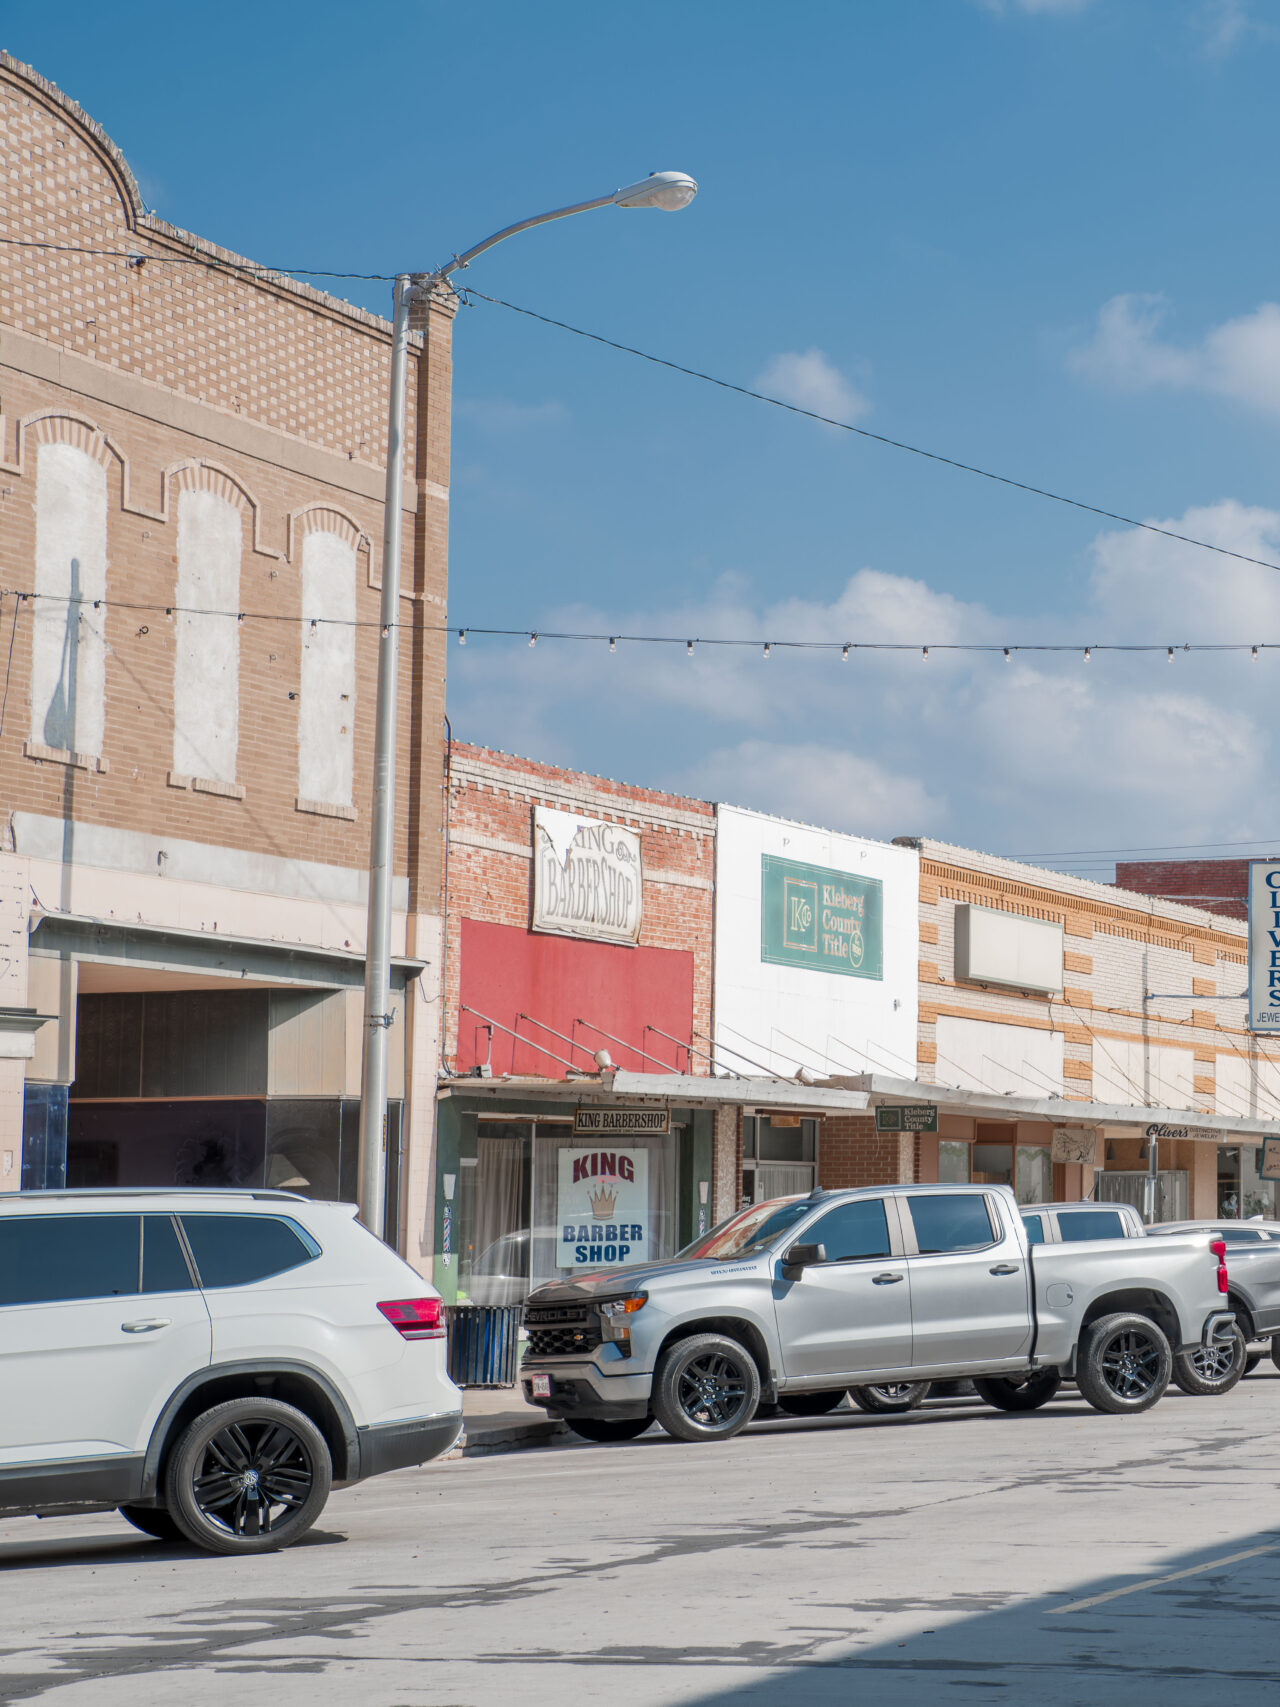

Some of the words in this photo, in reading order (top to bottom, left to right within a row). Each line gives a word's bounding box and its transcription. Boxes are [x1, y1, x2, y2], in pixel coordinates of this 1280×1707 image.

[573, 826, 615, 854] ING
[546, 857, 634, 928] BARBERSHOP
[822, 884, 865, 917] Kleberg
[822, 909, 862, 935] County
[822, 933, 849, 957] Title
[577, 1112, 600, 1128] KING
[602, 1112, 666, 1129] BARBERSHOP
[903, 1115, 933, 1124] County
[904, 1107, 935, 1116] Kleberg
[904, 1122, 924, 1130] Title
[1145, 1123, 1188, 1138] Oliver's
[573, 1152, 634, 1184] KING
[562, 1224, 643, 1243] BARBER
[575, 1244, 631, 1263] SHOP
